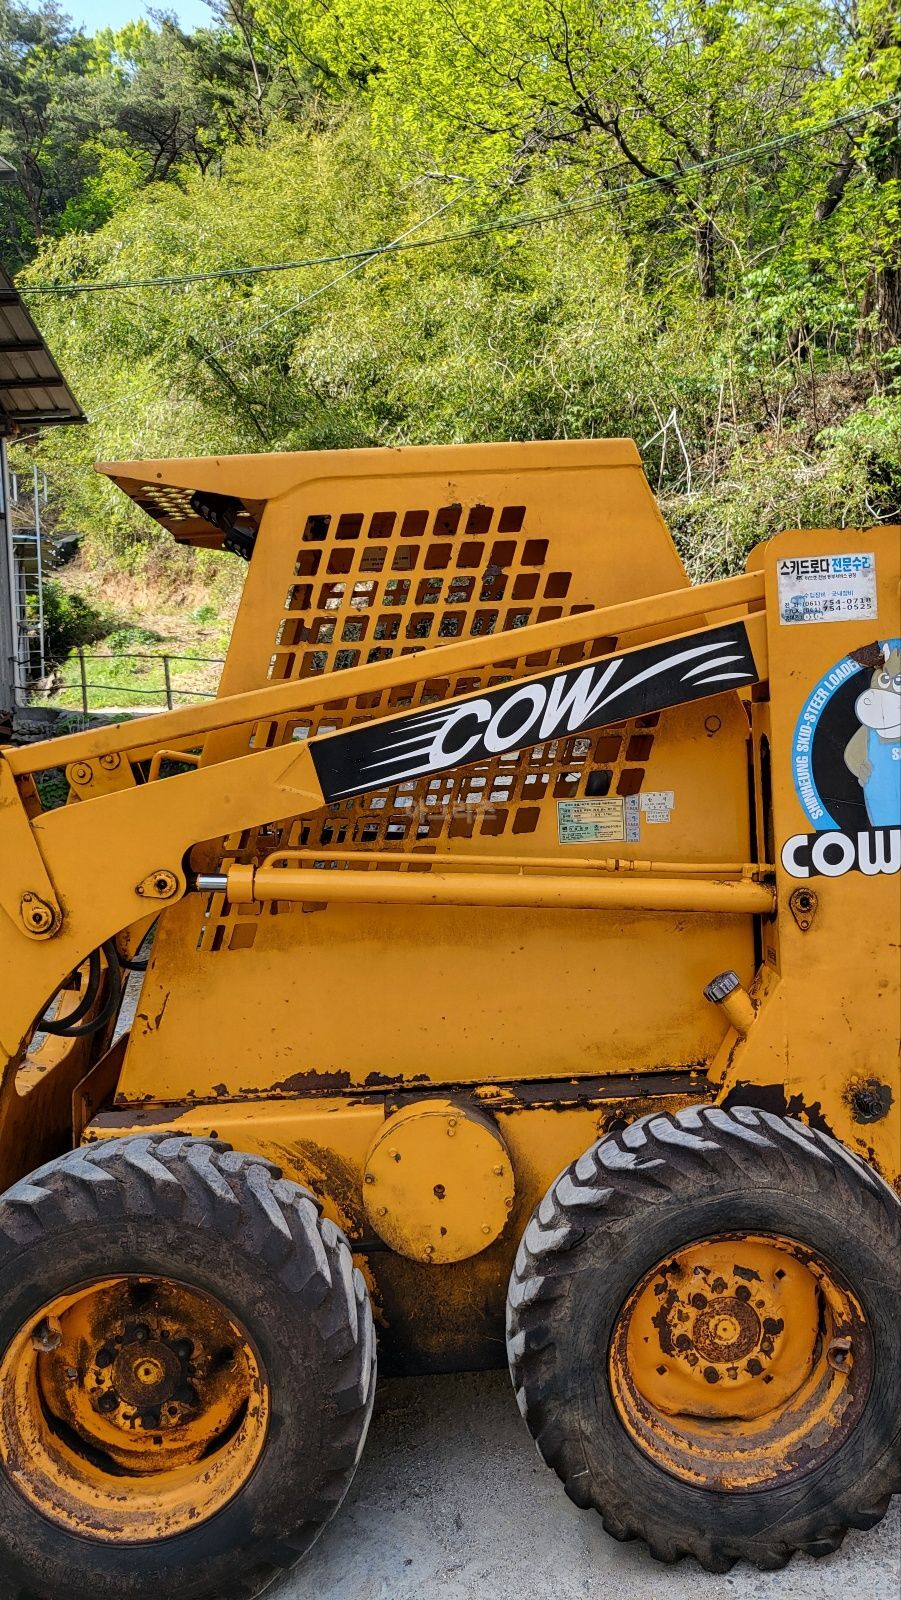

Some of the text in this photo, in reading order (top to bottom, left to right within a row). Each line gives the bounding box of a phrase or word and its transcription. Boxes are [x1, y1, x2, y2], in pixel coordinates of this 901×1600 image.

[780, 559, 830, 576] 스키드로다
[428, 658, 624, 768] COW
[796, 657, 862, 821] SHINHEUNG SKID-STEER LOADE
[782, 829, 901, 878] COW
